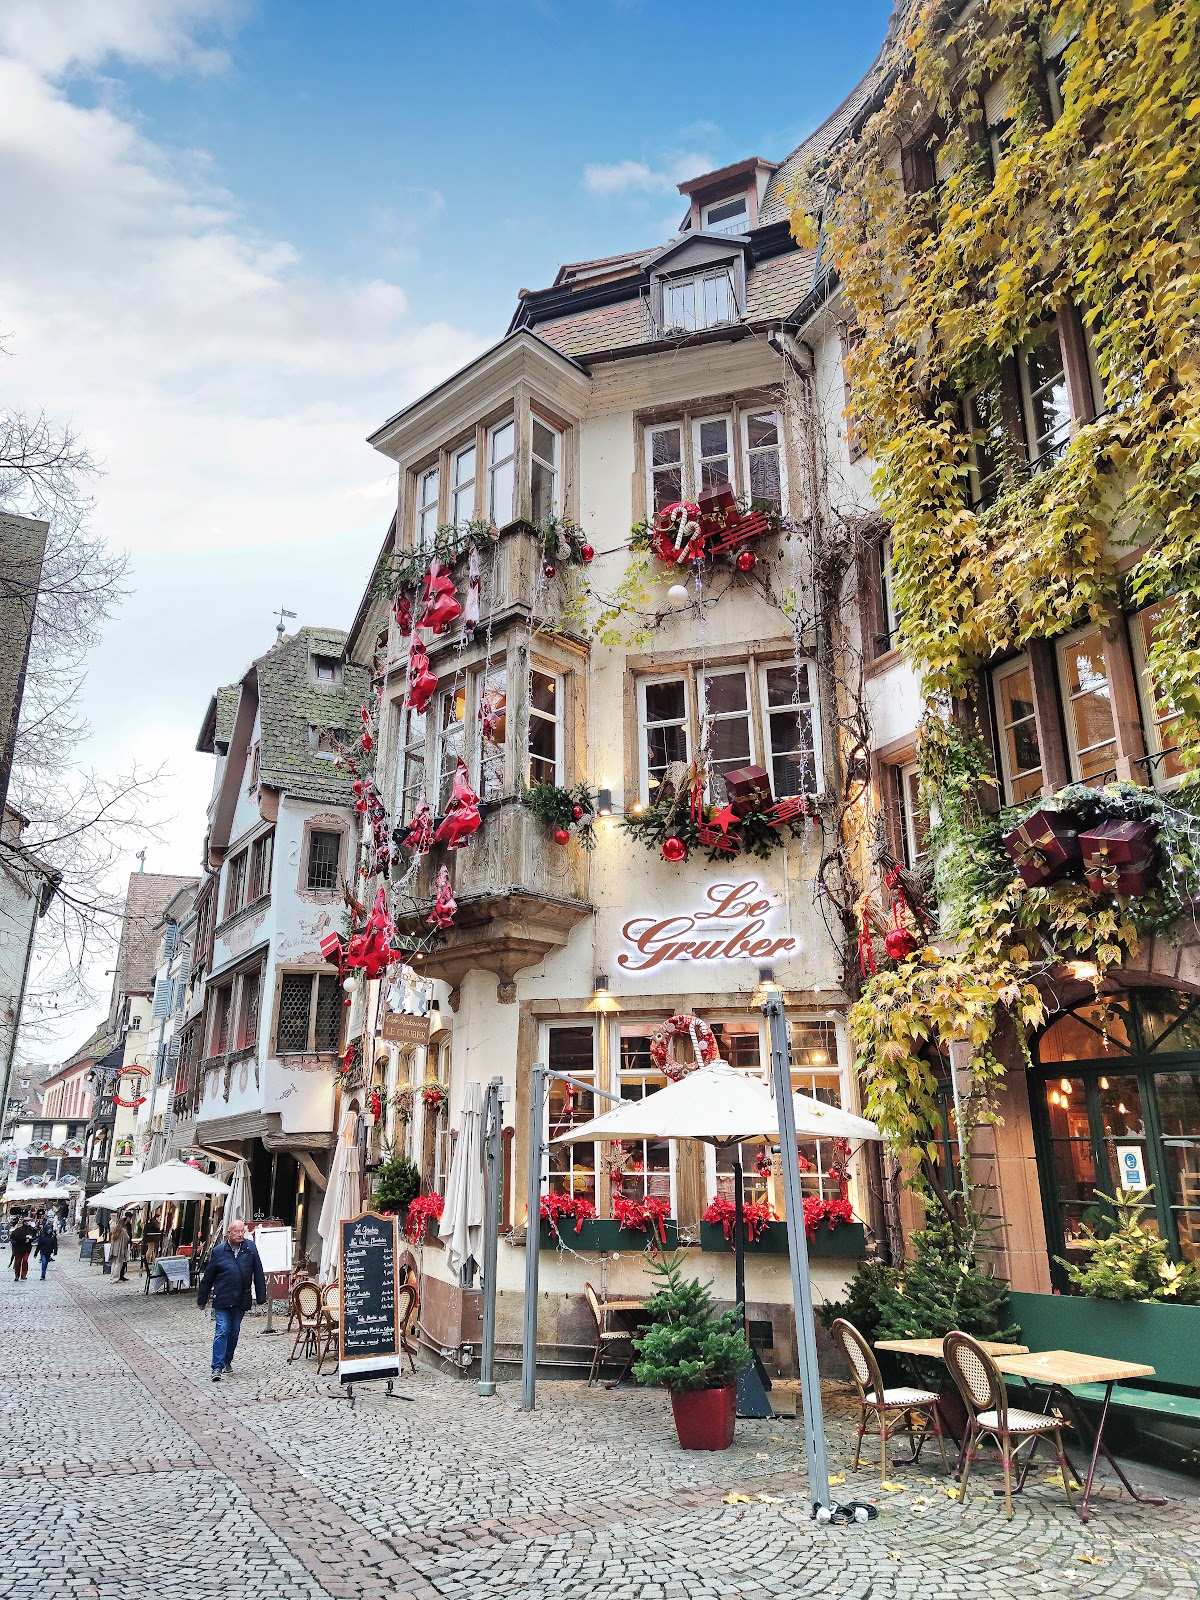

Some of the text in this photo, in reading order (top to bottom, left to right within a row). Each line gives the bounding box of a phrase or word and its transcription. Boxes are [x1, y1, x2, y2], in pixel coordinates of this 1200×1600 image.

[693, 880, 772, 920] Le
[617, 916, 797, 971] Gruber
[386, 1027, 426, 1040] LE GRUBER
